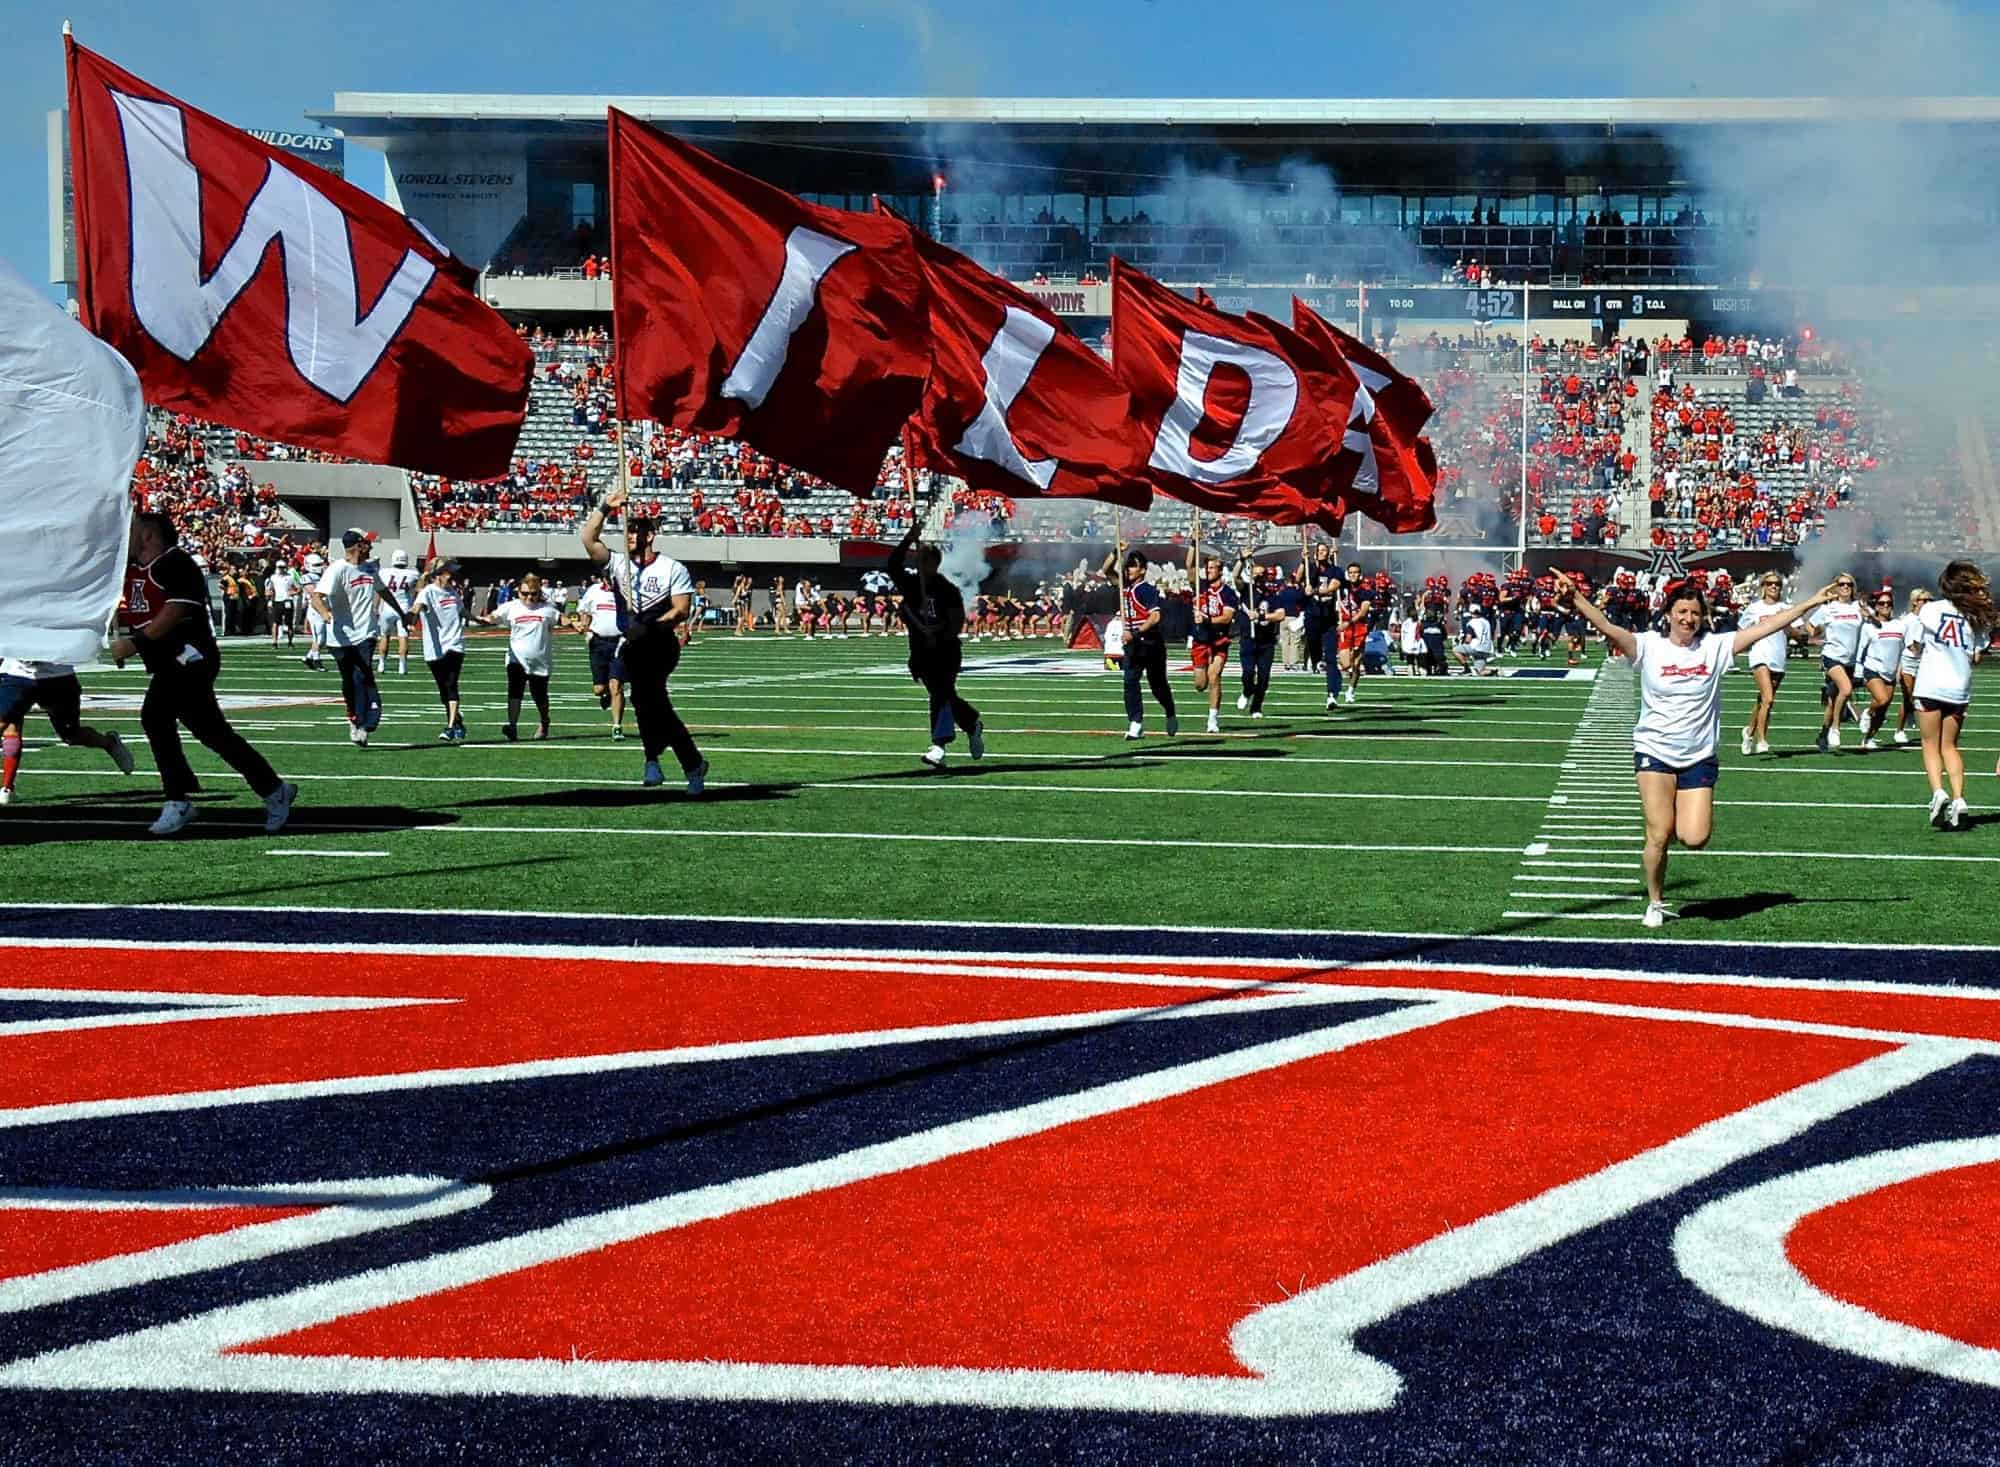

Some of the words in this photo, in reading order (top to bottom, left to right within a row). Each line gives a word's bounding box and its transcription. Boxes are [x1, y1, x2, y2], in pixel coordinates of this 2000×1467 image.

[246, 128, 334, 151] WILDCATS
[397, 173, 514, 185] LOWELL-STEVENS
[110, 87, 437, 405] W
[1390, 299, 1400, 308] TO
[1465, 291, 1514, 317] 4:52
[1552, 299, 1572, 309] BALL
[1573, 299, 1586, 309] ON
[1593, 295, 1601, 314] 1
[953, 304, 1059, 490] L
[1147, 327, 1299, 485] D
[388, 574, 410, 593] 44
[129, 579, 151, 613] A
[1934, 612, 1969, 650] A
